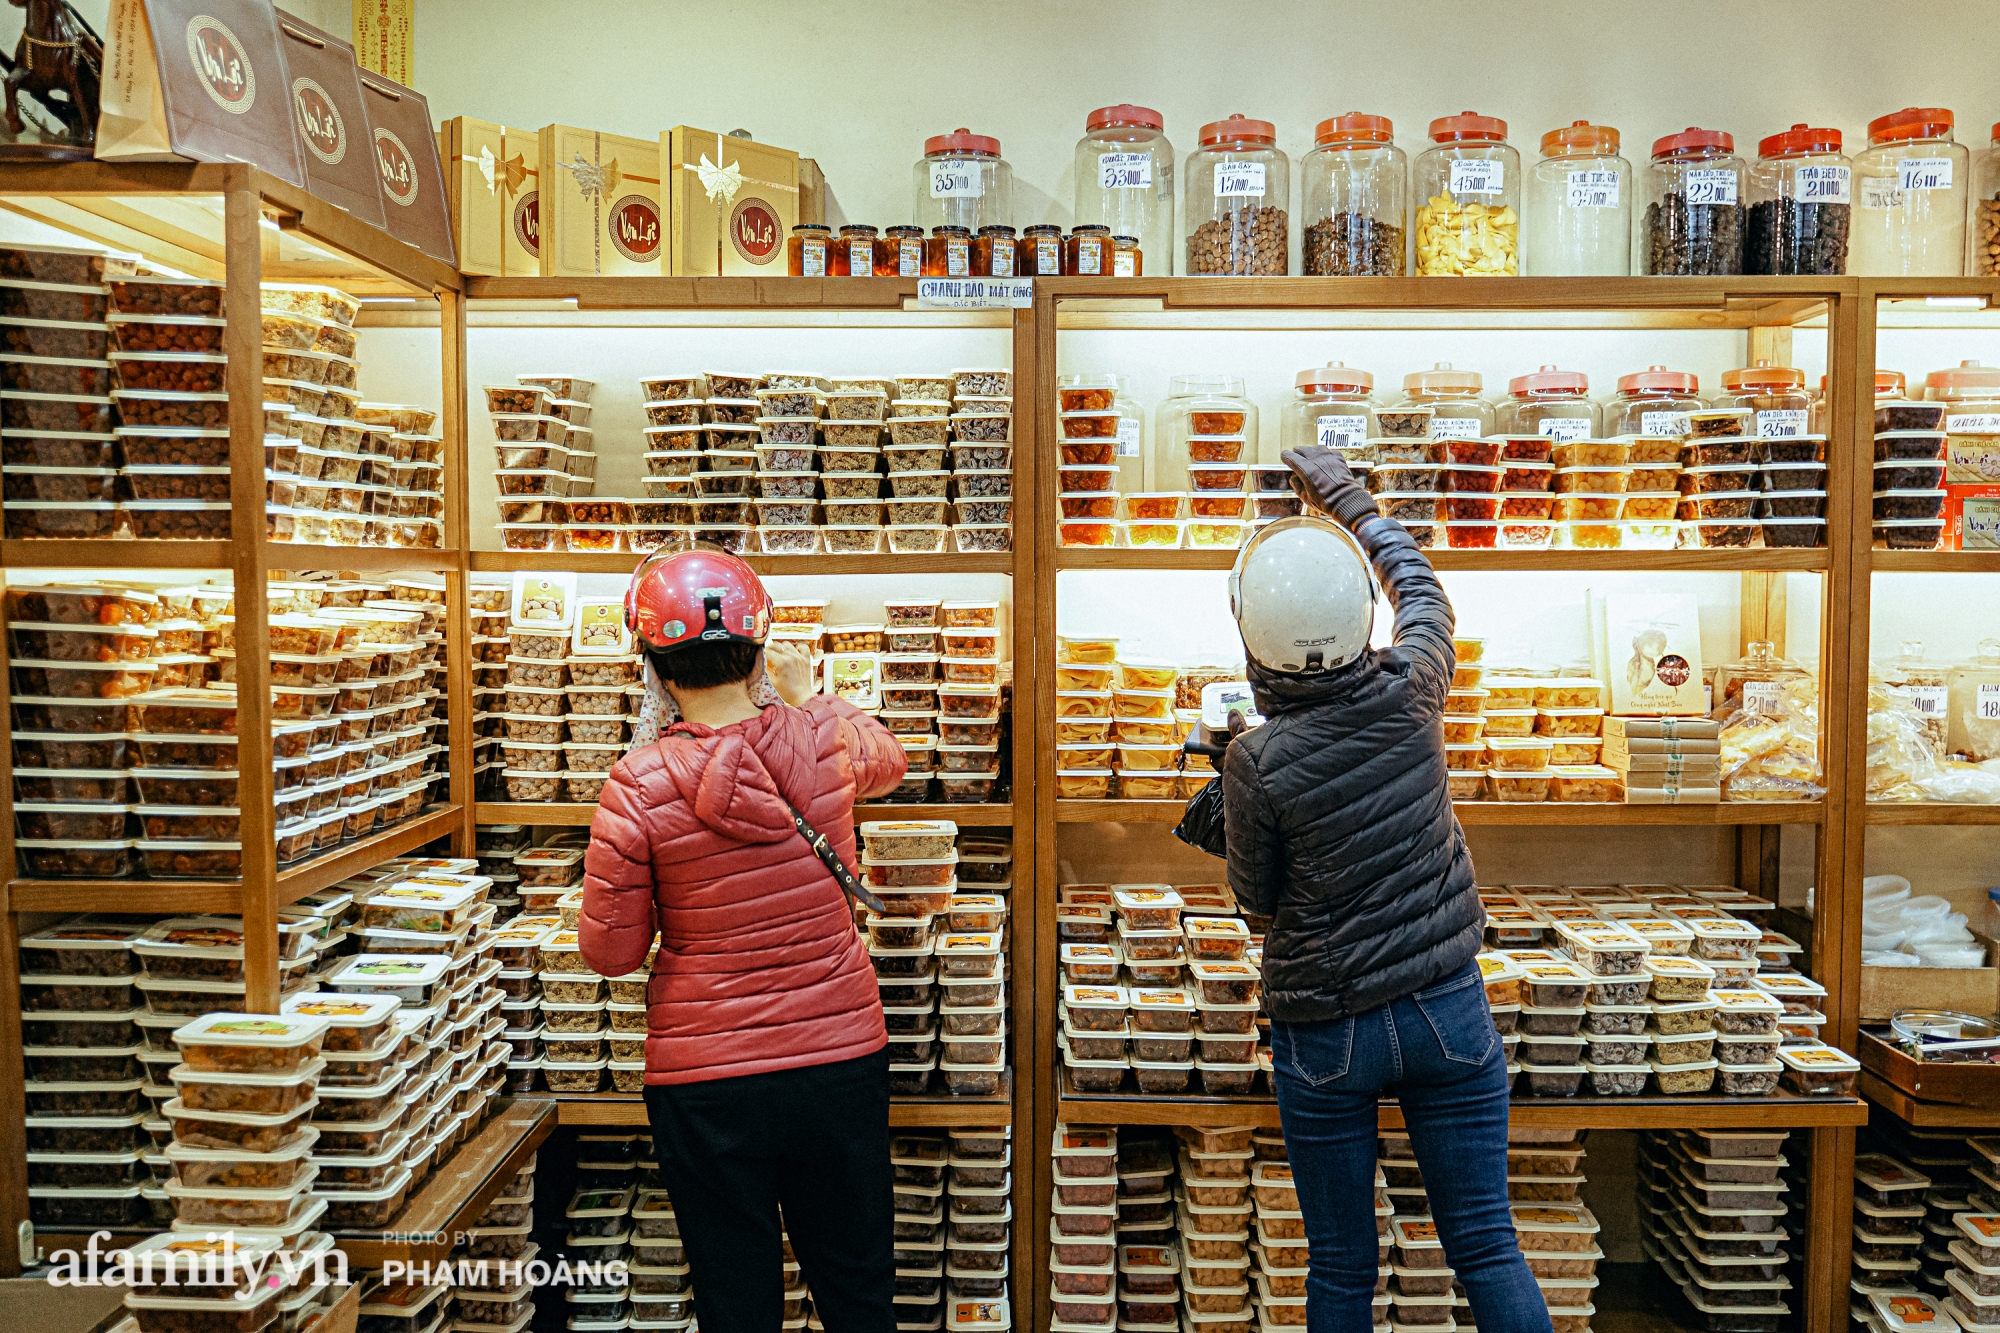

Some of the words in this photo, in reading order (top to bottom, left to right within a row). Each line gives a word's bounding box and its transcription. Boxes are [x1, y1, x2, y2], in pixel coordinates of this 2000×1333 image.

[1800, 166, 1818, 179] TÁO
[741, 213, 756, 245] Vạn
[922, 282, 960, 297] CHANH
[1012, 286, 1032, 298] ONG
[701, 630, 728, 640] GRS
[1982, 701, 2000, 717] 18
